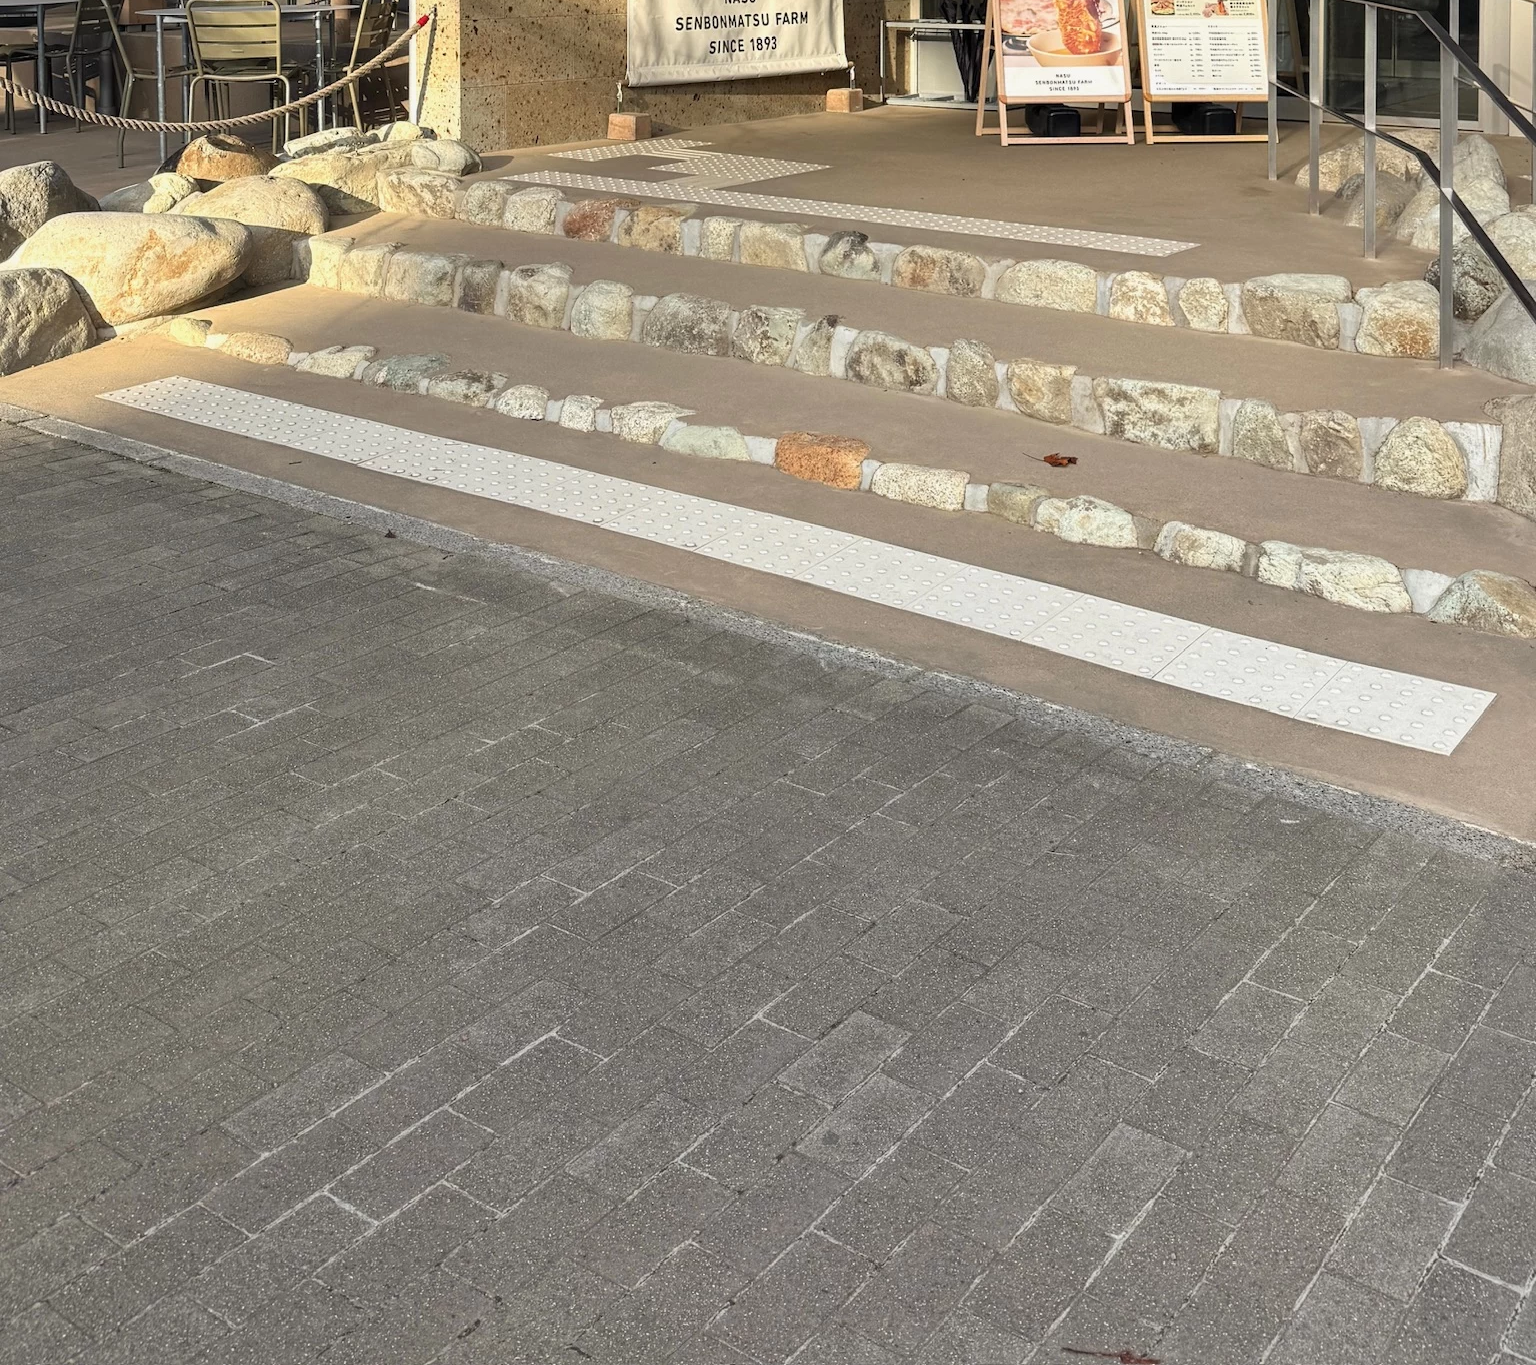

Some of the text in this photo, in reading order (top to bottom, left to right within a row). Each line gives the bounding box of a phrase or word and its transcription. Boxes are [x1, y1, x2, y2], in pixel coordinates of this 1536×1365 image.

[675, 11, 809, 31] SENBONMATSU FARM
[708, 36, 777, 54] SINCE 1893
